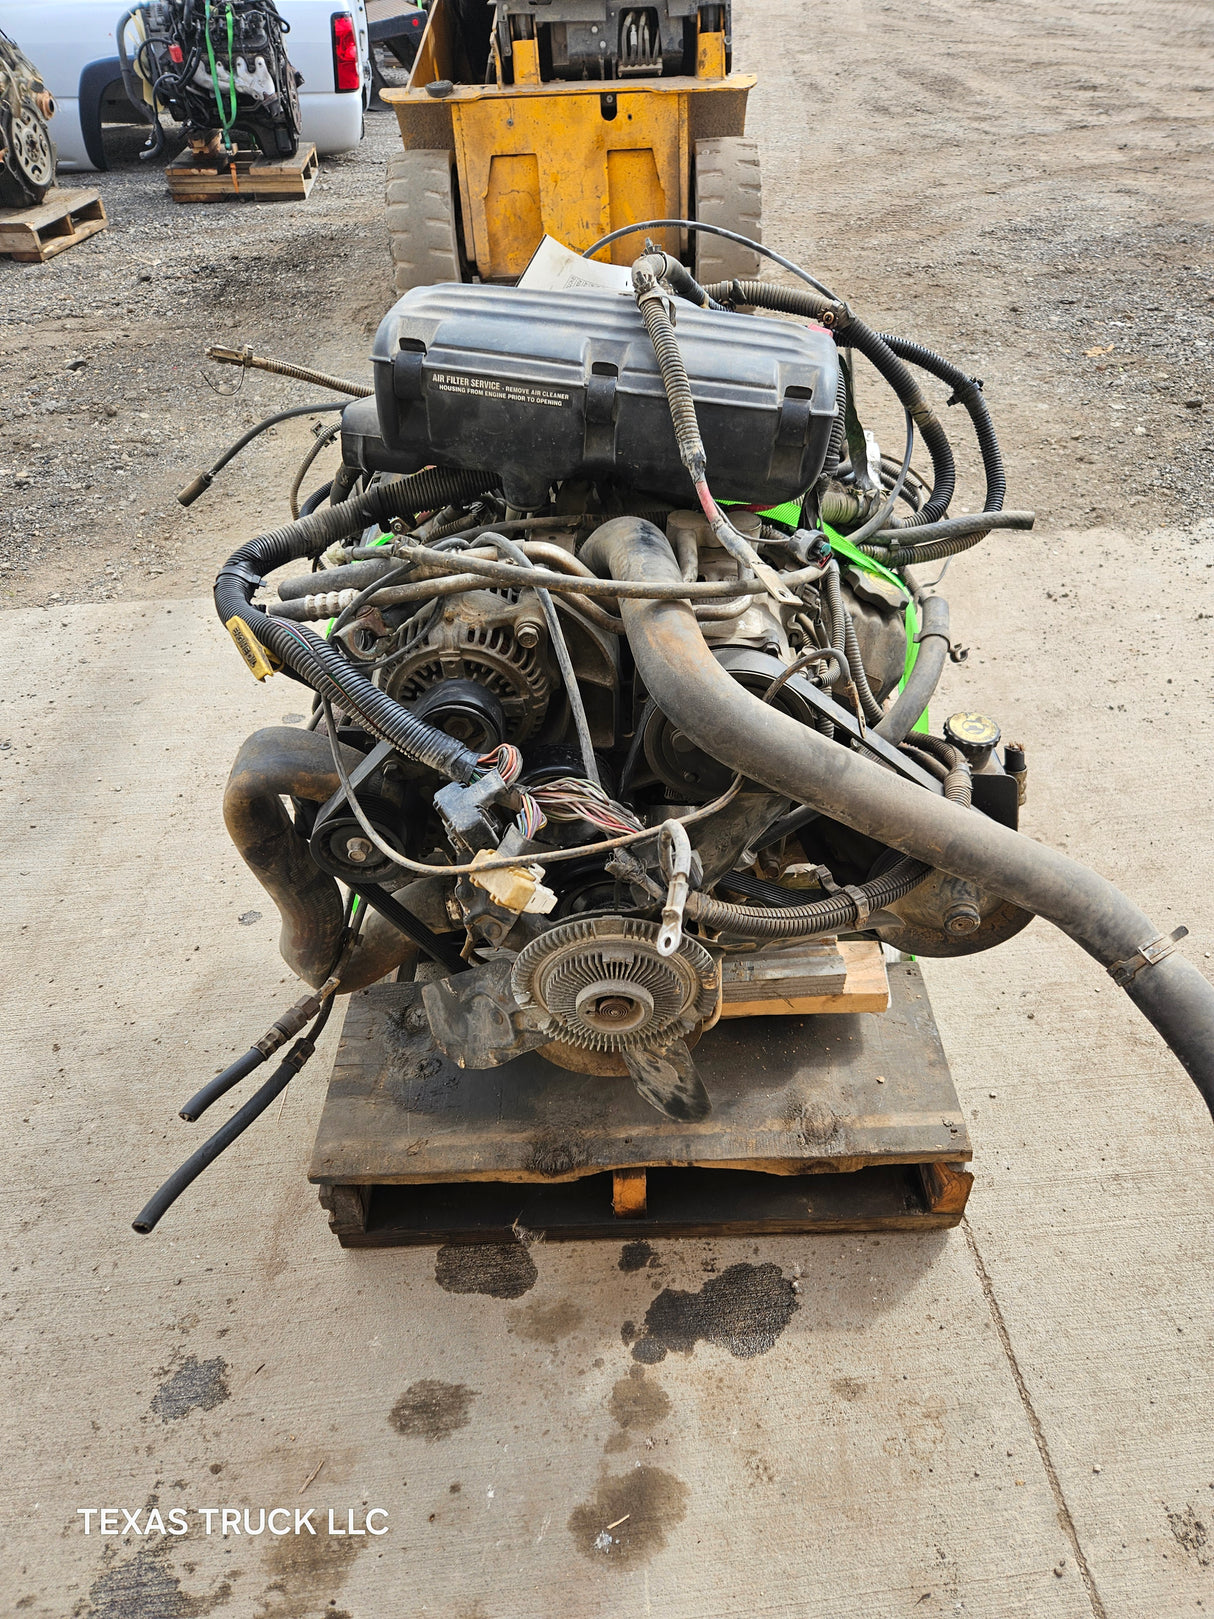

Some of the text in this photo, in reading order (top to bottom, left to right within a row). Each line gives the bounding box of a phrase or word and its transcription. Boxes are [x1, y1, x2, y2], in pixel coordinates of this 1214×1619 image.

[432, 373, 445, 383] AIR
[446, 375, 469, 386] FILTER
[470, 378, 500, 390] SERVICE
[505, 385, 529, 394] REMOVE
[542, 391, 569, 400] CLEANER
[439, 384, 466, 393] HOUSING
[467, 387, 484, 396] FROM
[484, 391, 506, 399] ENGINE
[507, 393, 526, 402] PRIOR
[536, 397, 562, 407] OPENING
